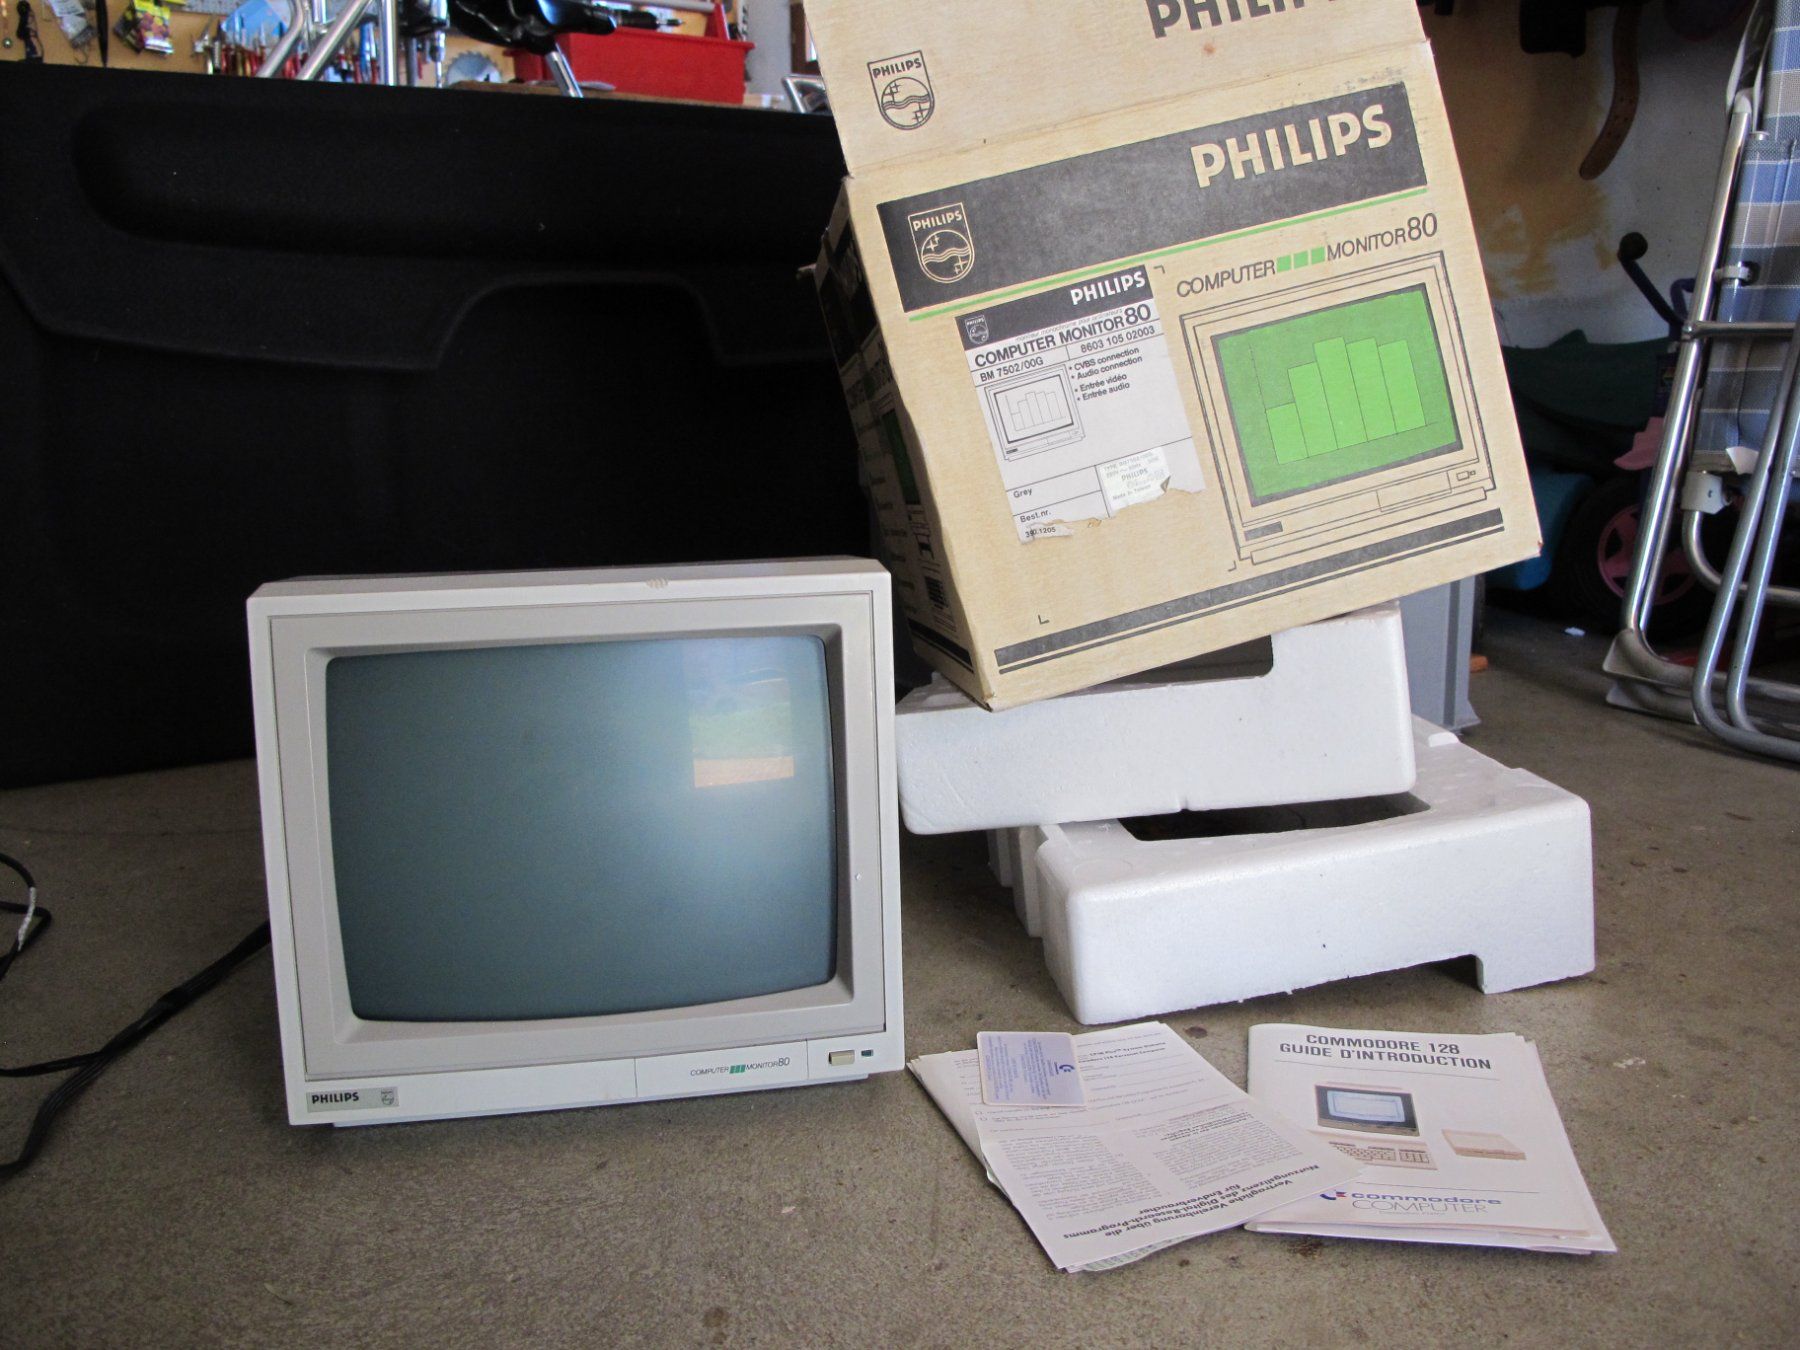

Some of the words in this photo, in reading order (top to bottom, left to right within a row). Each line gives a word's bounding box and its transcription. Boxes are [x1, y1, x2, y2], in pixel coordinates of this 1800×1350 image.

[1148, 0, 1336, 39] PHIL
[872, 58, 922, 78] PHILIPS
[1191, 104, 1392, 188] PHILIPS
[912, 210, 963, 231] PHILIPS
[1070, 270, 1146, 305] PHILIPS
[1177, 259, 1276, 298] COMPUTER
[1080, 340, 1104, 353] 8603
[1106, 334, 1124, 346] 105
[1126, 325, 1155, 340] 02003
[975, 334, 1056, 367] COMPUTER
[1074, 358, 1096, 371] CVBS
[1097, 347, 1139, 364] connection
[980, 371, 995, 382] BM
[997, 357, 1044, 377] 7502/00G
[1077, 368, 1099, 380] Audio
[1100, 356, 1143, 373] connection
[1080, 380, 1105, 392] Entrée
[1082, 388, 1107, 401] Entrée
[1109, 382, 1130, 393] audio
[1013, 488, 1032, 498] Grey
[1306, 1034, 1420, 1052] COMMODORE
[1428, 1042, 1460, 1055] 128
[1279, 1042, 1332, 1058] GUIDE
[1341, 1049, 1492, 1070] D'INTRODUCTION
[690, 1066, 729, 1077] COMPUTER
[312, 1092, 359, 1104] PHILIPS
[1220, 1191, 1239, 1201] des
[1225, 1183, 1241, 1192] für
[1228, 1180, 1293, 1207] Vertragliche
[1351, 1192, 1502, 1205] commodore
[1352, 1200, 1488, 1213] COMPUTER
[1154, 1203, 1228, 1224] Vereinbarung
[1105, 1229, 1122, 1238] die
[1126, 1221, 1152, 1232] über
